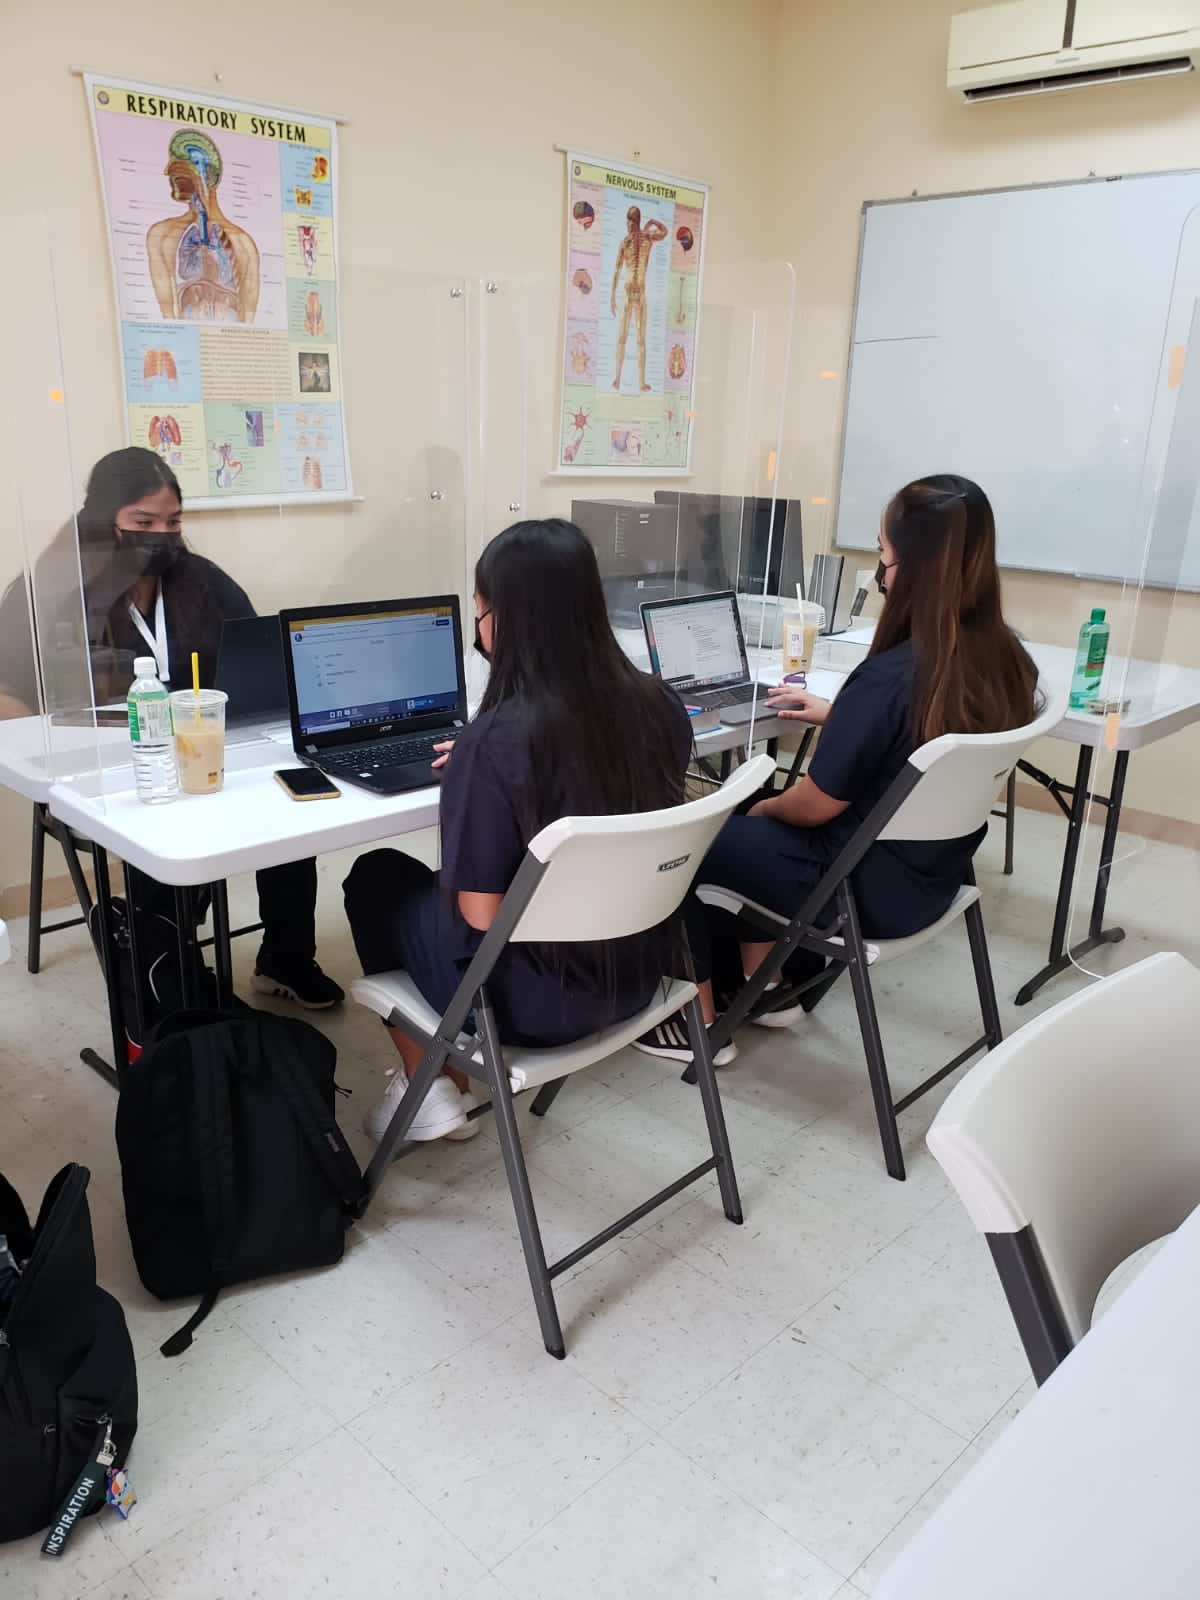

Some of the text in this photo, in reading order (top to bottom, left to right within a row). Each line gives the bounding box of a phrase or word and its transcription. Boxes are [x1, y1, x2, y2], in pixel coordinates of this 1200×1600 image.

[127, 94, 306, 143] RESPIRATORY SYSTEM
[605, 173, 645, 192] NERVOUS
[646, 183, 677, 200] SYSTEM
[45, 1477, 96, 1555] INSPIRATION
